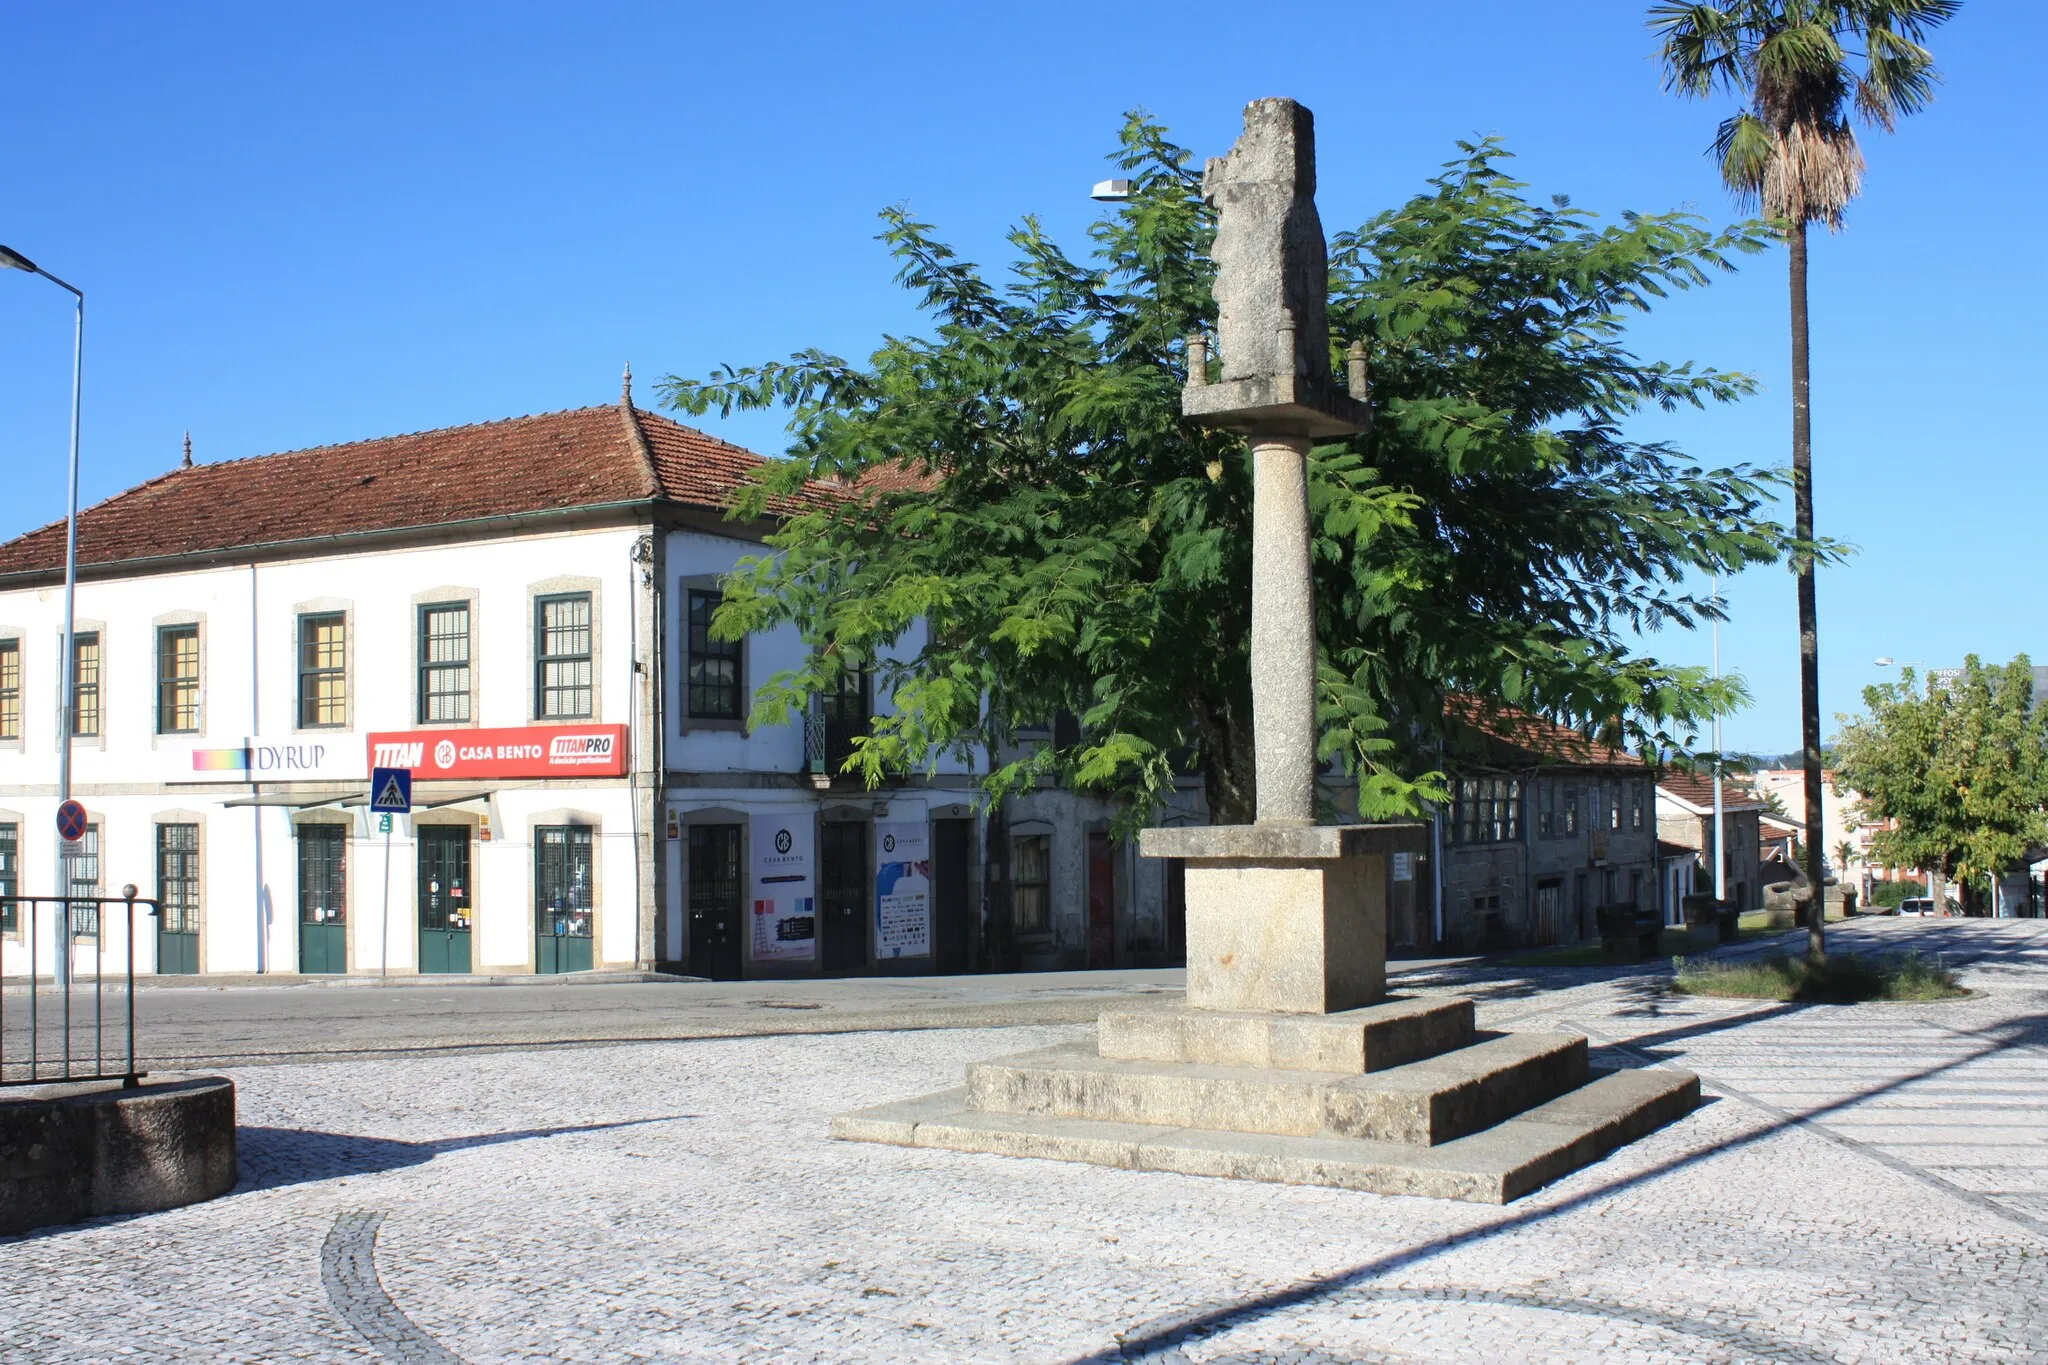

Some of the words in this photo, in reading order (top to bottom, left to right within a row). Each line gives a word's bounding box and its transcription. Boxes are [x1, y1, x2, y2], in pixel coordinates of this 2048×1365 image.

[374, 742, 424, 768] TITAN
[459, 746, 493, 760] CASA
[497, 745, 542, 759] BENTO
[556, 738, 611, 753] TITANPRO
[258, 745, 325, 770] DYRUP
